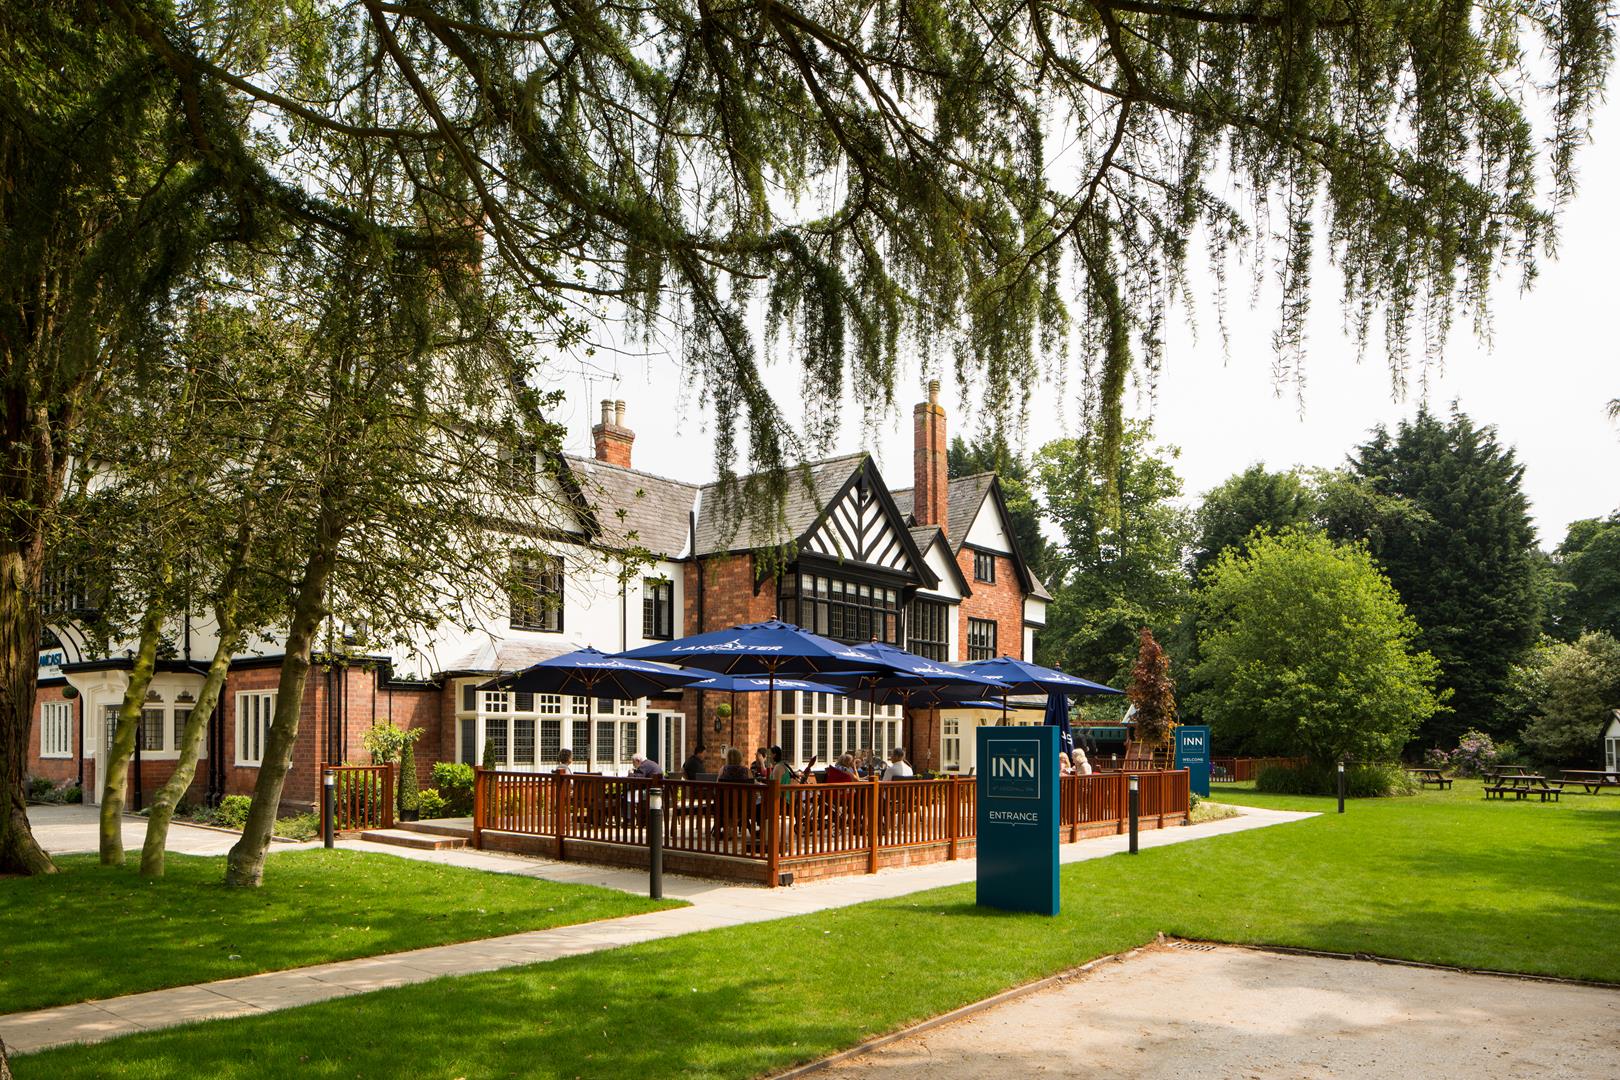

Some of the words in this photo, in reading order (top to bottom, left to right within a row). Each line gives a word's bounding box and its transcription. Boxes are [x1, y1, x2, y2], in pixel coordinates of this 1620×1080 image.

[1183, 737, 1203, 746] INN
[992, 757, 1034, 778] INN
[989, 811, 1038, 822] ENTRANCE
